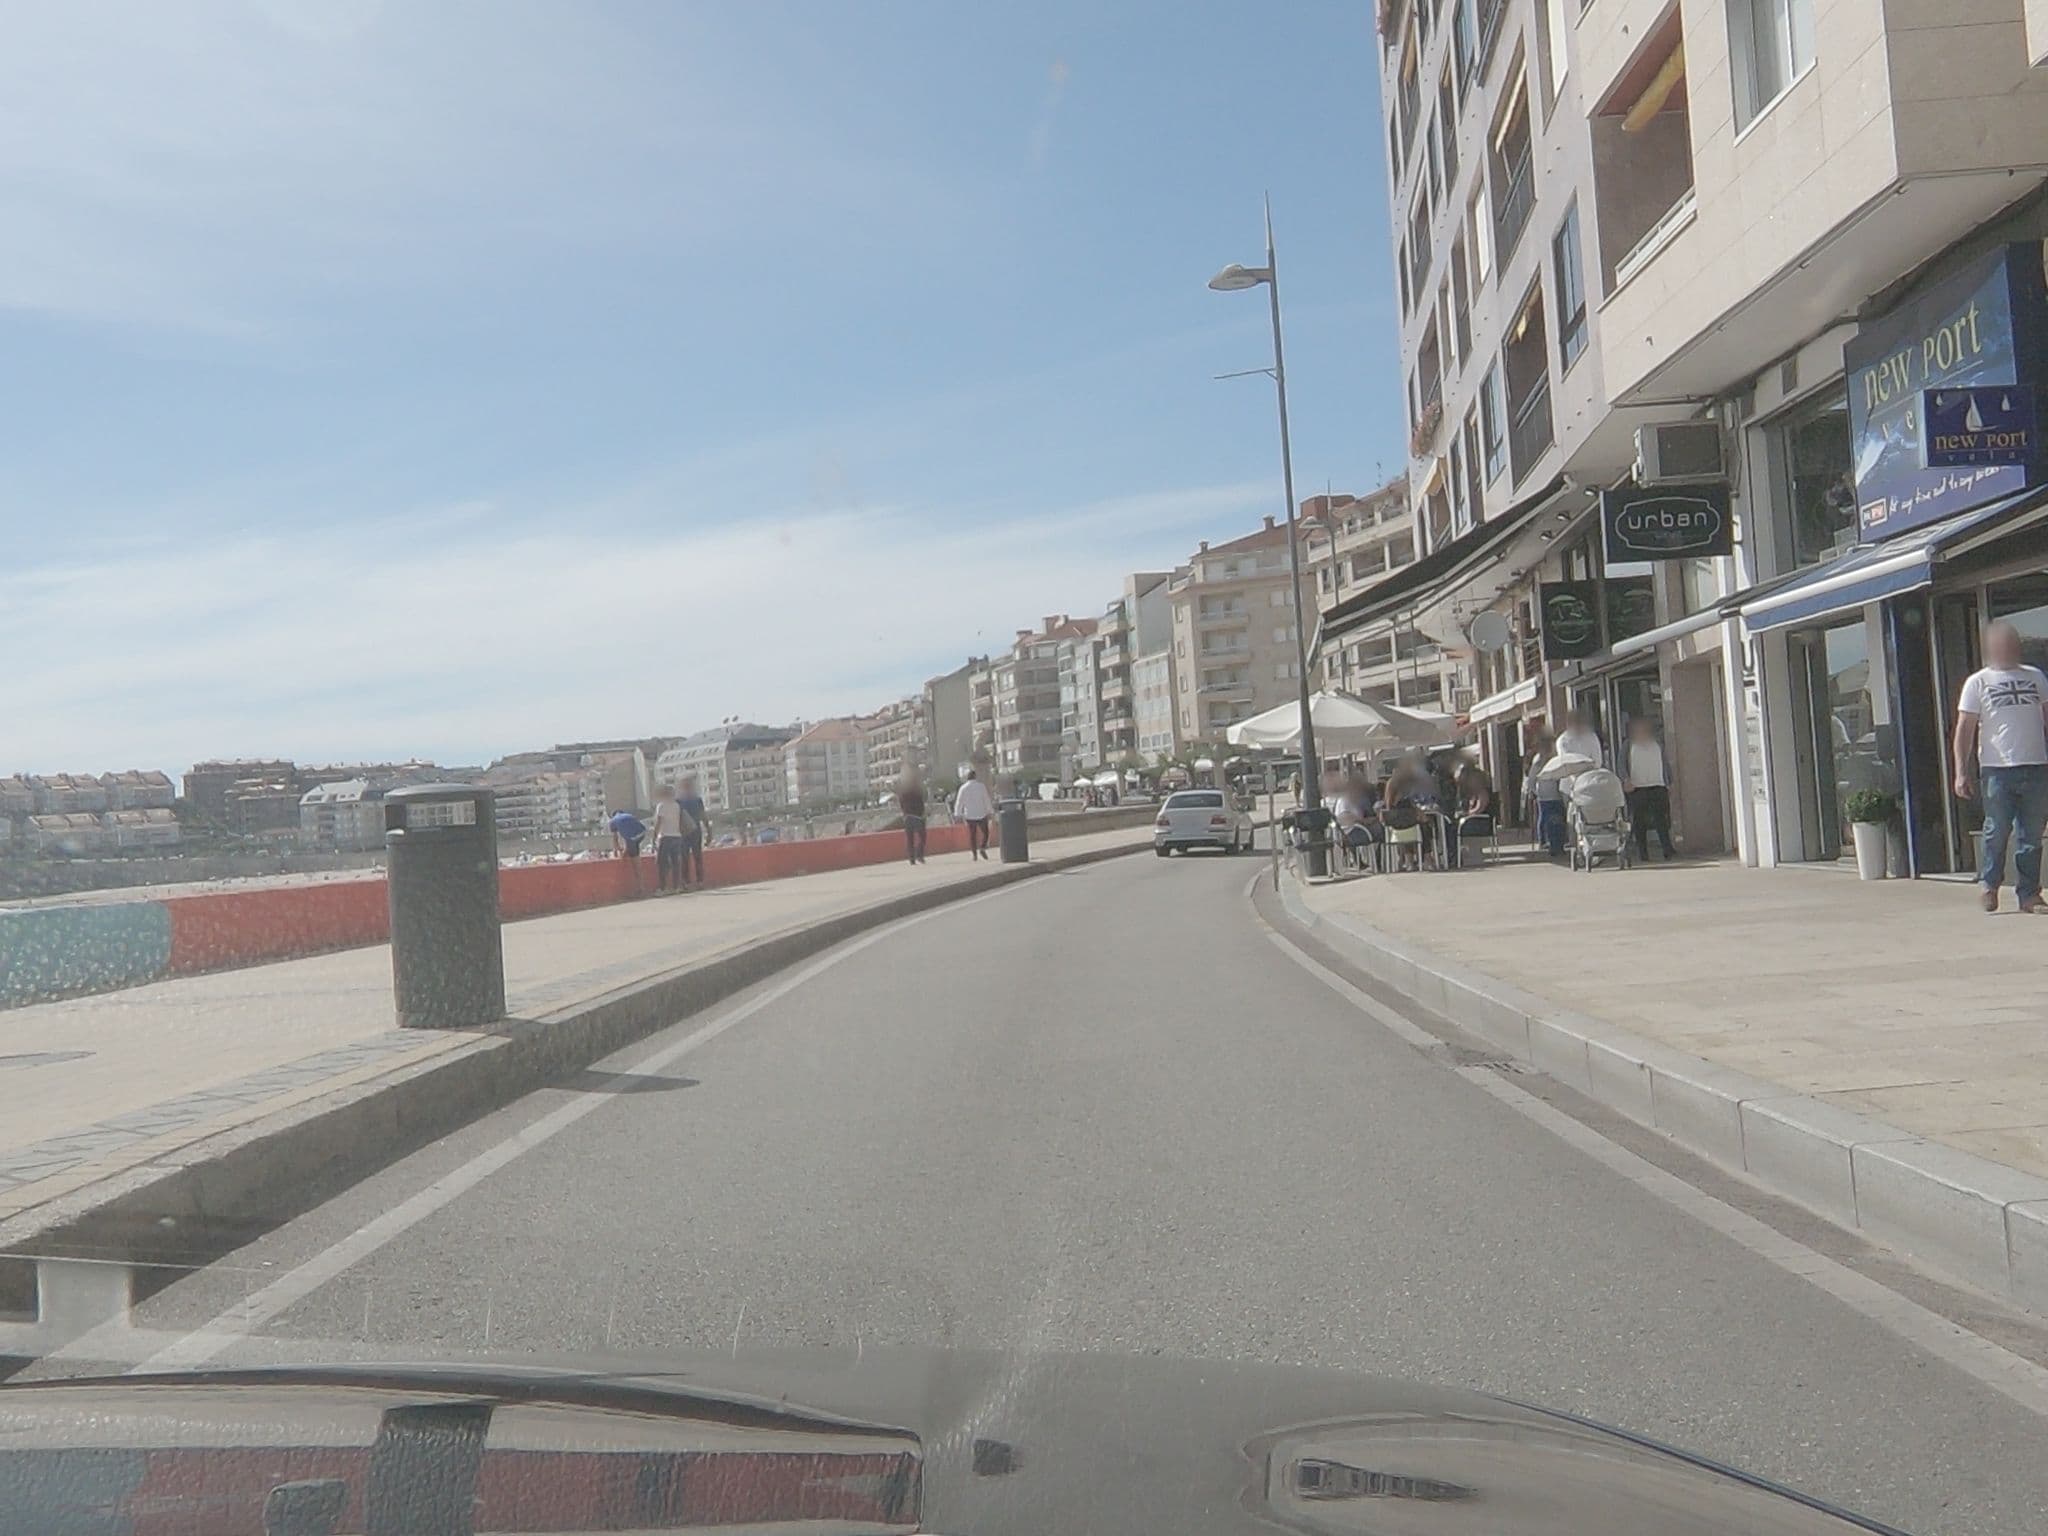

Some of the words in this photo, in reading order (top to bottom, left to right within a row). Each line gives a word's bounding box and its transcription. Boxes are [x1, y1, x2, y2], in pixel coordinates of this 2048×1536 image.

[1864, 347, 1912, 409] new
[1935, 434, 1978, 450] new
[1627, 509, 1708, 529] urban
